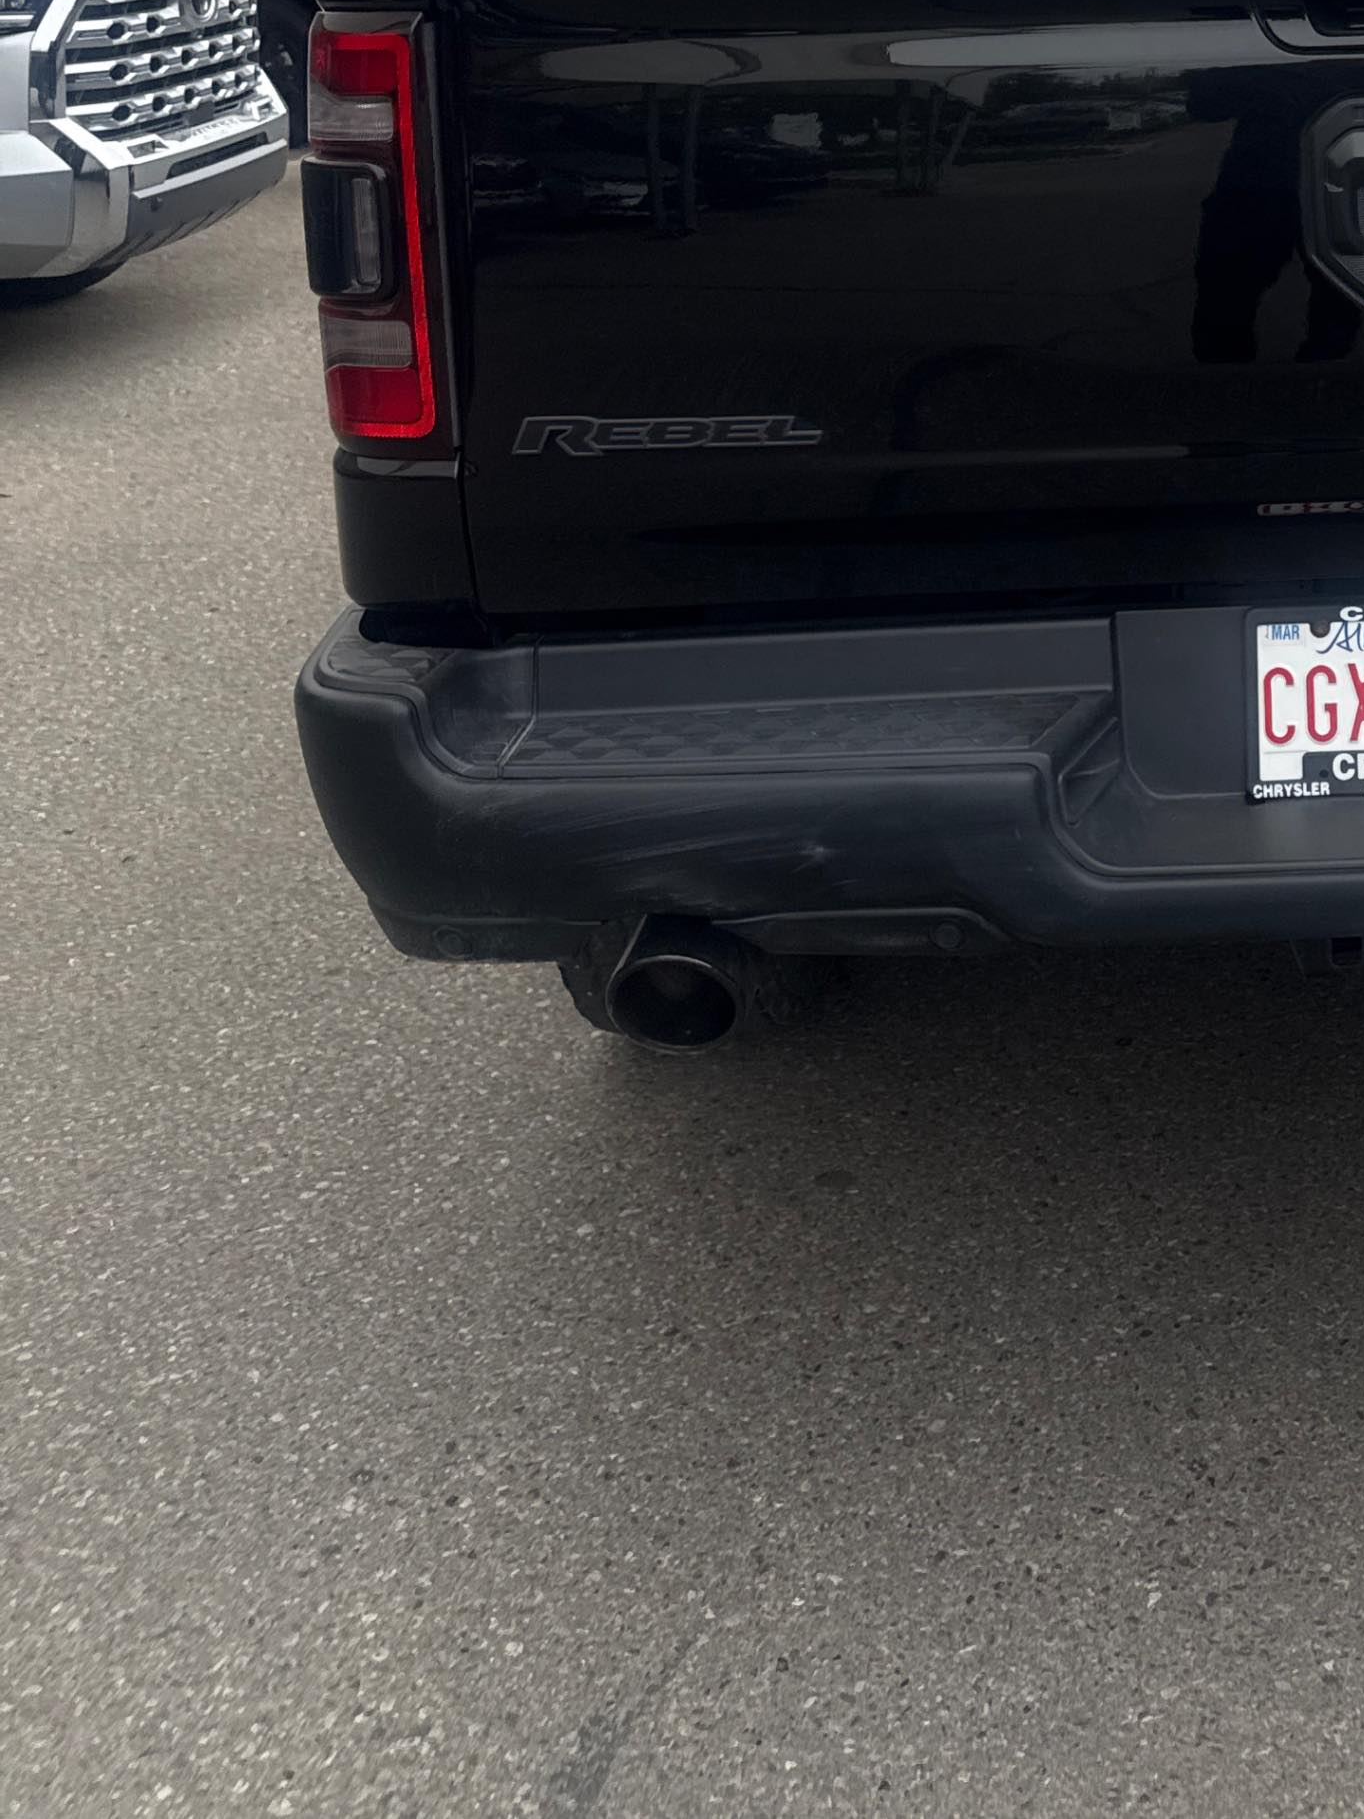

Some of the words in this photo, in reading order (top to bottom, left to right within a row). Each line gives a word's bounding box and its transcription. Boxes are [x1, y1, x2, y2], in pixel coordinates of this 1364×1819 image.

[511, 415, 823, 457] REBEL
[1271, 624, 1300, 641] MAR
[1252, 781, 1331, 799] CHRYSLER
